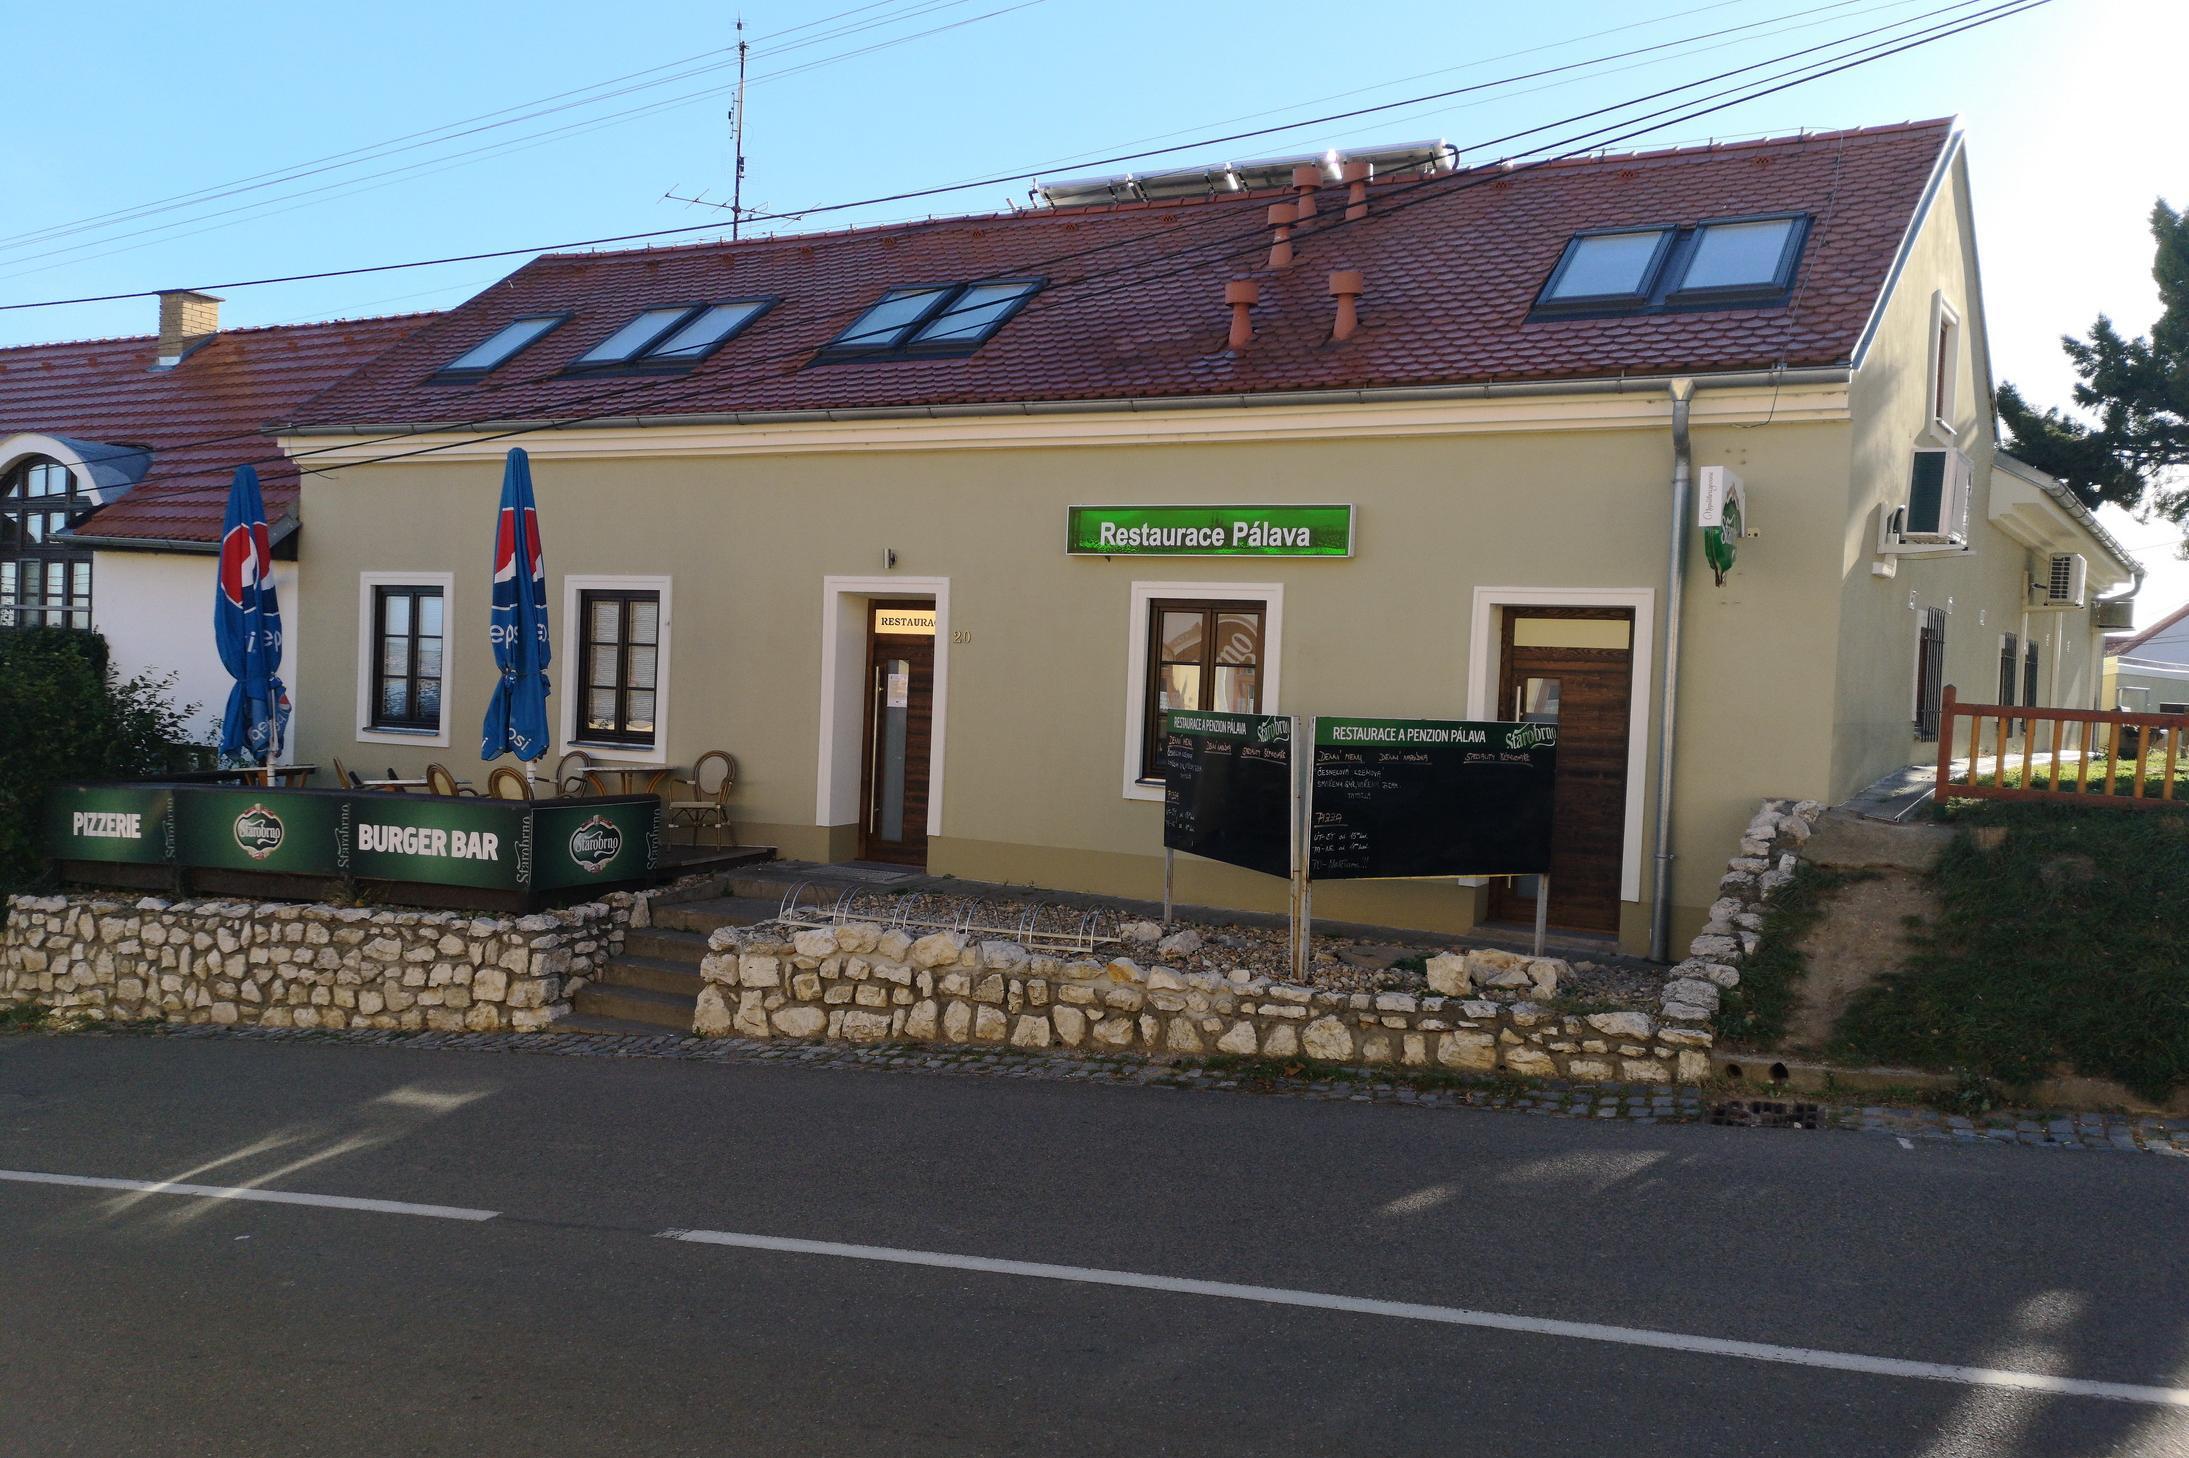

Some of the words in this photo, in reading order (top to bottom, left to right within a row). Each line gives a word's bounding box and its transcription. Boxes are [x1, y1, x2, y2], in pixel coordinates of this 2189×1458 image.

[1100, 521, 1225, 547] Restaurace
[1232, 520, 1310, 547] Pálava
[881, 617, 936, 627] RESTAURA
[953, 630, 972, 644] 20
[1174, 716, 1201, 731] RESTAURACE
[1206, 720, 1227, 733] PENZION
[1227, 718, 1247, 735] PÁLAVA
[1333, 726, 1397, 742] RESTAURACE
[1398, 728, 1405, 742] A
[1407, 728, 1449, 743] PENZION
[1450, 726, 1487, 744] PÁLAVA
[1505, 722, 1557, 750] Starobrno
[73, 811, 142, 839] PIZZERIE
[358, 823, 447, 857] BURGER
[451, 830, 499, 861] BAR
[514, 816, 531, 883] Starobrno
[572, 830, 619, 858] Starobrno
